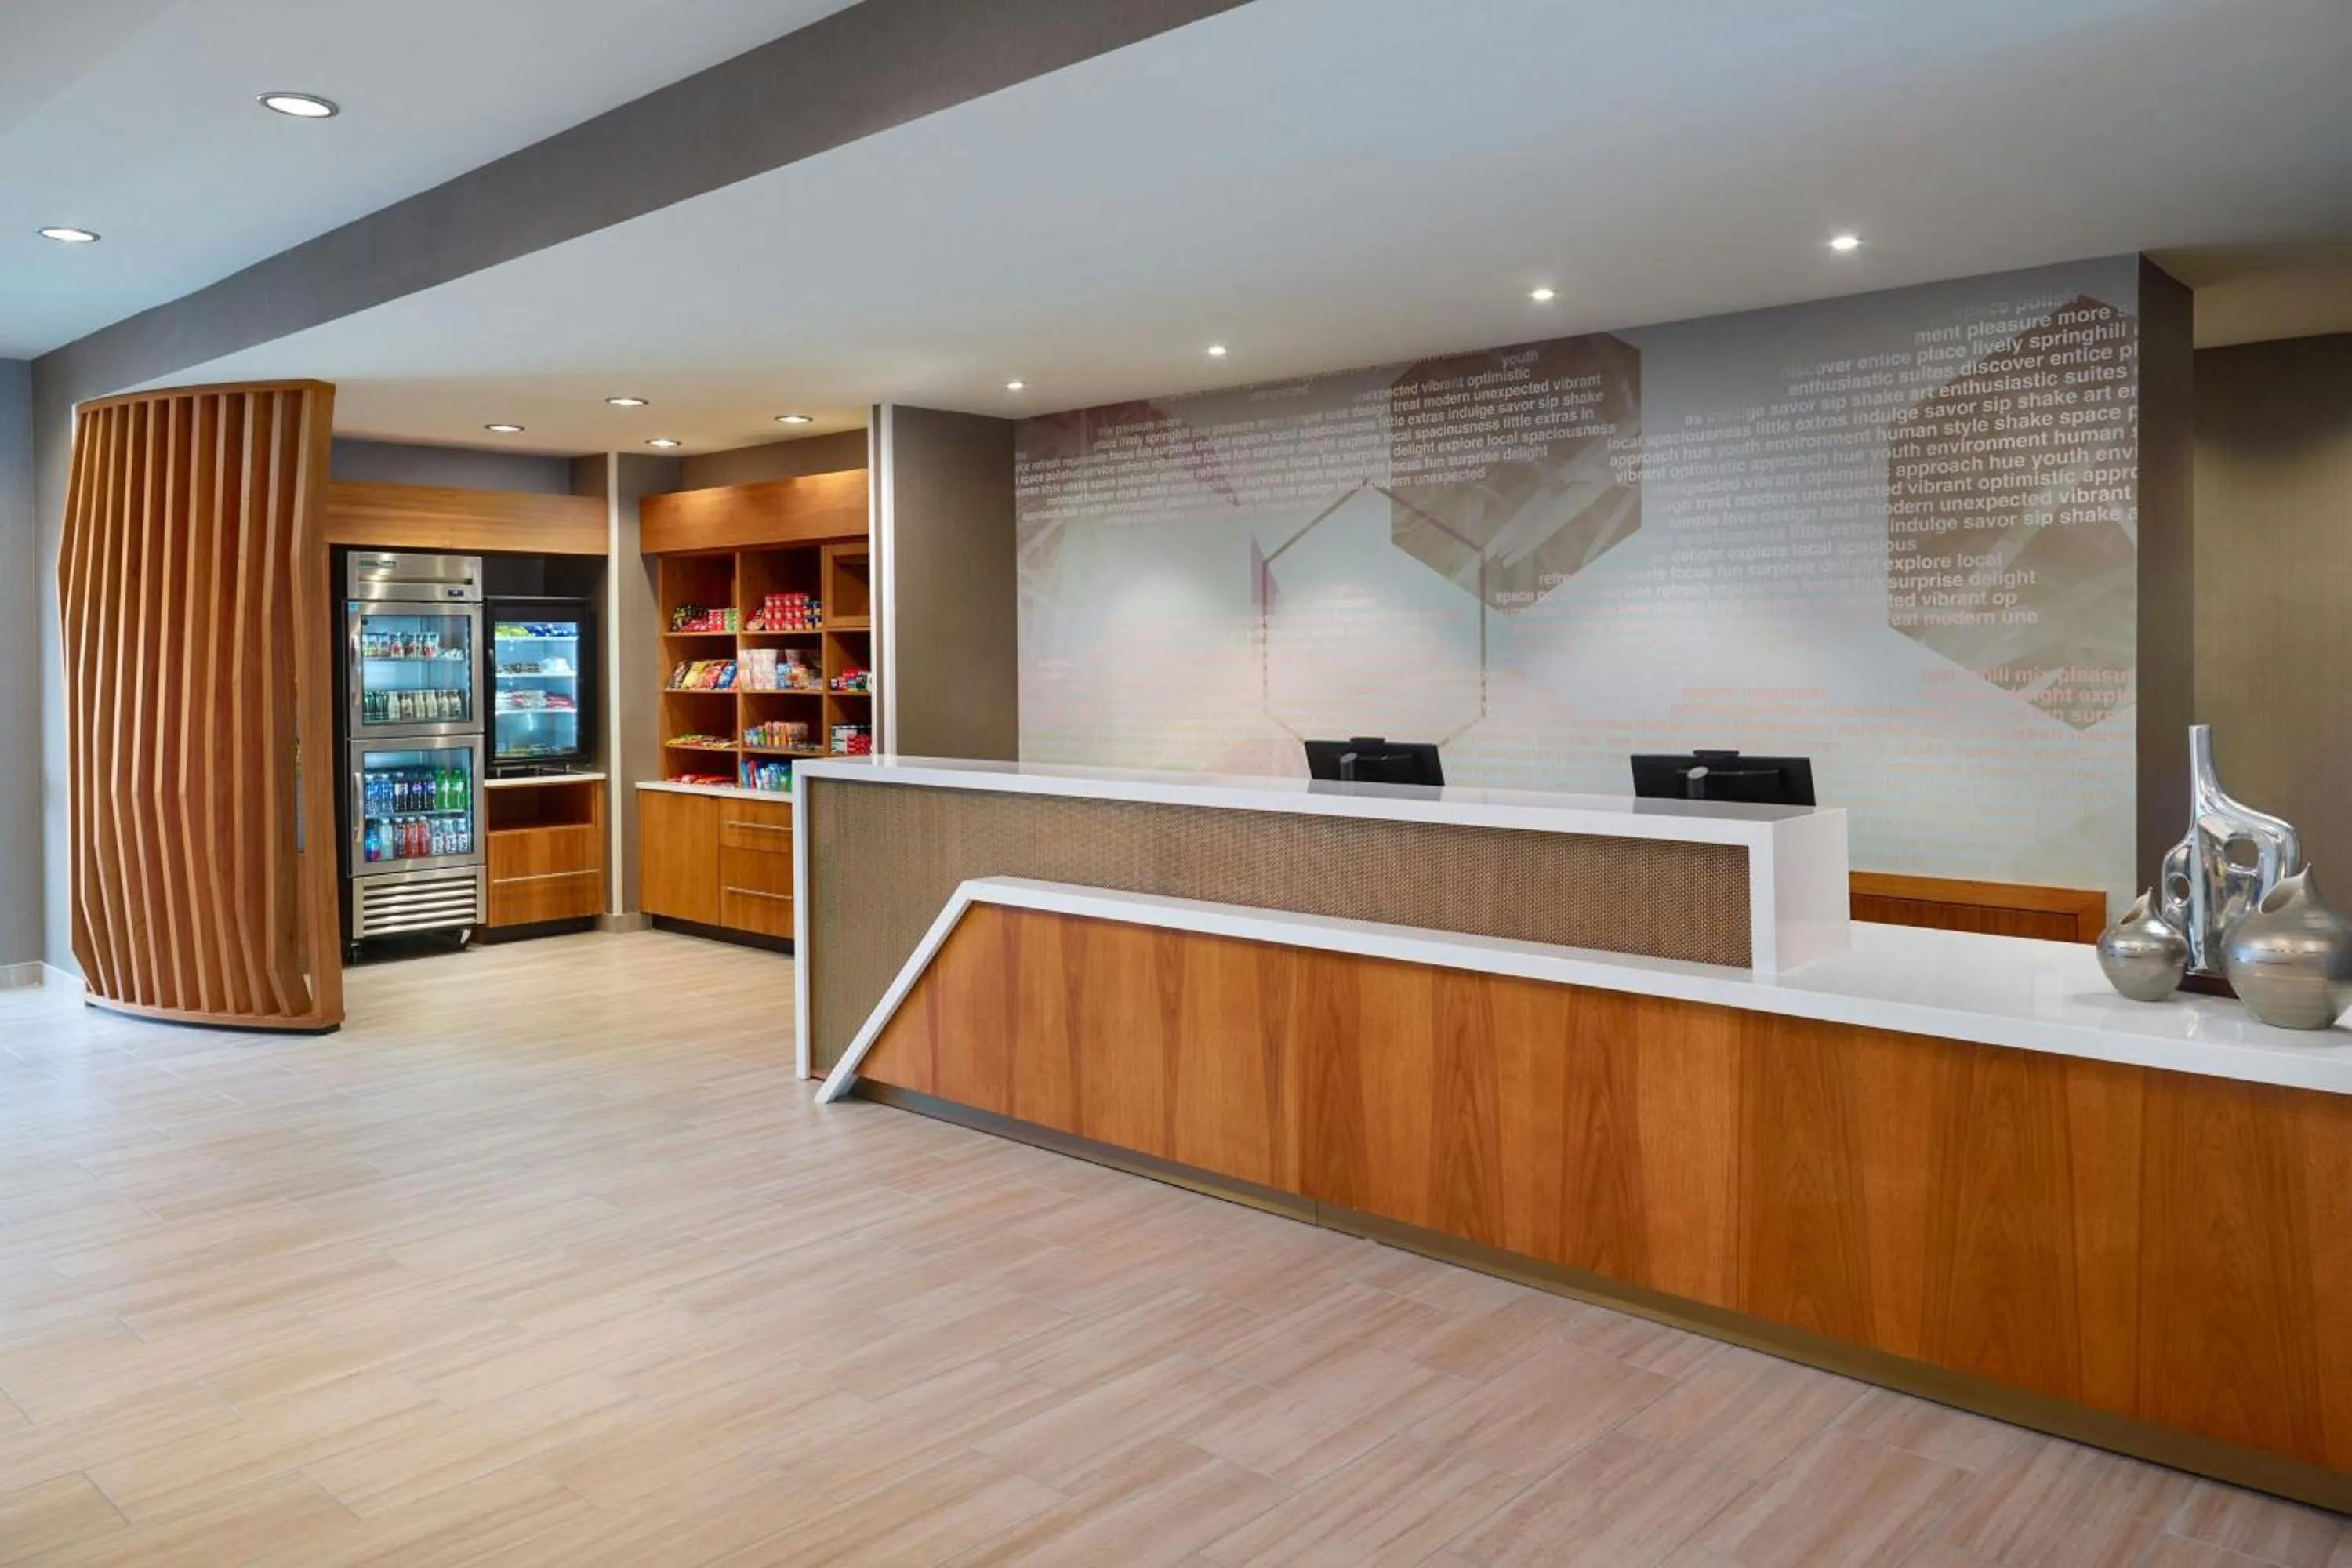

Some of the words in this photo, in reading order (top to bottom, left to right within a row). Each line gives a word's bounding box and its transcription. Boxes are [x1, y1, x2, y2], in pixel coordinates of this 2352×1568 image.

[1967, 314, 2052, 341] pleasure
[2058, 307, 2111, 325] more
[1501, 350, 1540, 368] youth
[1857, 351, 1911, 370] entice
[1917, 345, 1967, 366] place
[1973, 337, 2023, 355] lively
[2029, 321, 2126, 350] springhill
[1421, 377, 1465, 393] vibrant
[1467, 368, 1530, 389] optimistic
[1788, 372, 1894, 396] enthusiastic
[1899, 364, 1955, 383] suites
[1959, 354, 2044, 376] discover
[2049, 346, 2113, 366] entice
[1393, 397, 1421, 412] treat
[1424, 392, 1470, 408] modern
[1473, 379, 1549, 401] unexpected
[1552, 372, 1602, 391] vibrant
[1769, 400, 1816, 416] savor
[1820, 394, 1846, 412] sip
[1851, 389, 1904, 408] shake
[1908, 384, 1935, 401] art
[1939, 371, 2058, 398] enthusiastic
[2064, 365, 2127, 384] suites
[1379, 416, 1406, 430] little
[1407, 410, 1445, 426] extras
[1448, 403, 1494, 420] indulge
[1498, 399, 1535, 414] savor
[1538, 395, 1559, 411] sip
[1562, 390, 1605, 406] shake
[1384, 427, 1411, 443] local
[1415, 419, 1500, 441] spaciousness
[1503, 414, 1531, 429] little
[1535, 410, 1578, 426] extras
[1581, 408, 1594, 421] in
[1607, 436, 1643, 452] local
[1755, 417, 1792, 435] little
[1795, 415, 1848, 431] extras
[1853, 406, 1919, 425] indulge
[1924, 401, 1977, 419] savor
[1982, 395, 2012, 414] sip
[2017, 390, 2078, 409] shake
[2083, 385, 2112, 402] art
[1393, 442, 1435, 458] delight
[1438, 437, 1484, 455] explore
[1487, 431, 1518, 446] local
[1522, 424, 1617, 445] spaciousness
[1610, 447, 1679, 468] approach
[1683, 445, 1712, 460] hue
[1716, 440, 1761, 459] youth
[1765, 429, 1871, 452] environment
[1875, 424, 1938, 441] human
[1944, 417, 1989, 437] style
[1994, 412, 2053, 430] shake
[2060, 406, 2122, 427] space
[1425, 456, 1445, 469] fun
[1448, 449, 1500, 467] surprise
[1503, 445, 1548, 463] delight
[1615, 466, 1666, 483] vibrant
[1669, 459, 1747, 481] optimistic
[1751, 451, 1828, 474] approach
[1832, 449, 1866, 463] hue
[1870, 442, 1921, 463] youth
[1926, 430, 2048, 456] environment
[2054, 426, 2125, 445] human
[1743, 472, 1800, 488] vibrant
[1805, 462, 1890, 487] optimistic
[1896, 456, 1984, 479] approach
[1989, 454, 2025, 470] hue
[2032, 447, 2089, 470] youth
[1414, 466, 1486, 485] unexpected
[1735, 491, 1797, 507] modern
[1802, 481, 1902, 503] unexpected
[1907, 476, 1973, 495] vibrant
[1978, 470, 2076, 492] optimistic
[1723, 510, 1757, 524] love
[1760, 506, 1817, 524] design
[1865, 499, 1933, 516] modern
[1940, 489, 2052, 512] unexpected
[2060, 485, 2132, 504] vibrant
[1890, 516, 1958, 535] indulge
[1963, 514, 2018, 529] savor
[2024, 509, 2053, 527] sip
[2060, 506, 2121, 524] shake
[1728, 544, 1788, 562] explore
[1792, 539, 1832, 558] local
[1882, 554, 1951, 573] explore
[1957, 550, 2003, 568] local
[1888, 572, 1964, 592] surprise
[1969, 570, 2036, 590] delight
[1922, 590, 1987, 607] vibrant
[1992, 591, 2017, 608] op
[1924, 609, 1996, 626] modern
